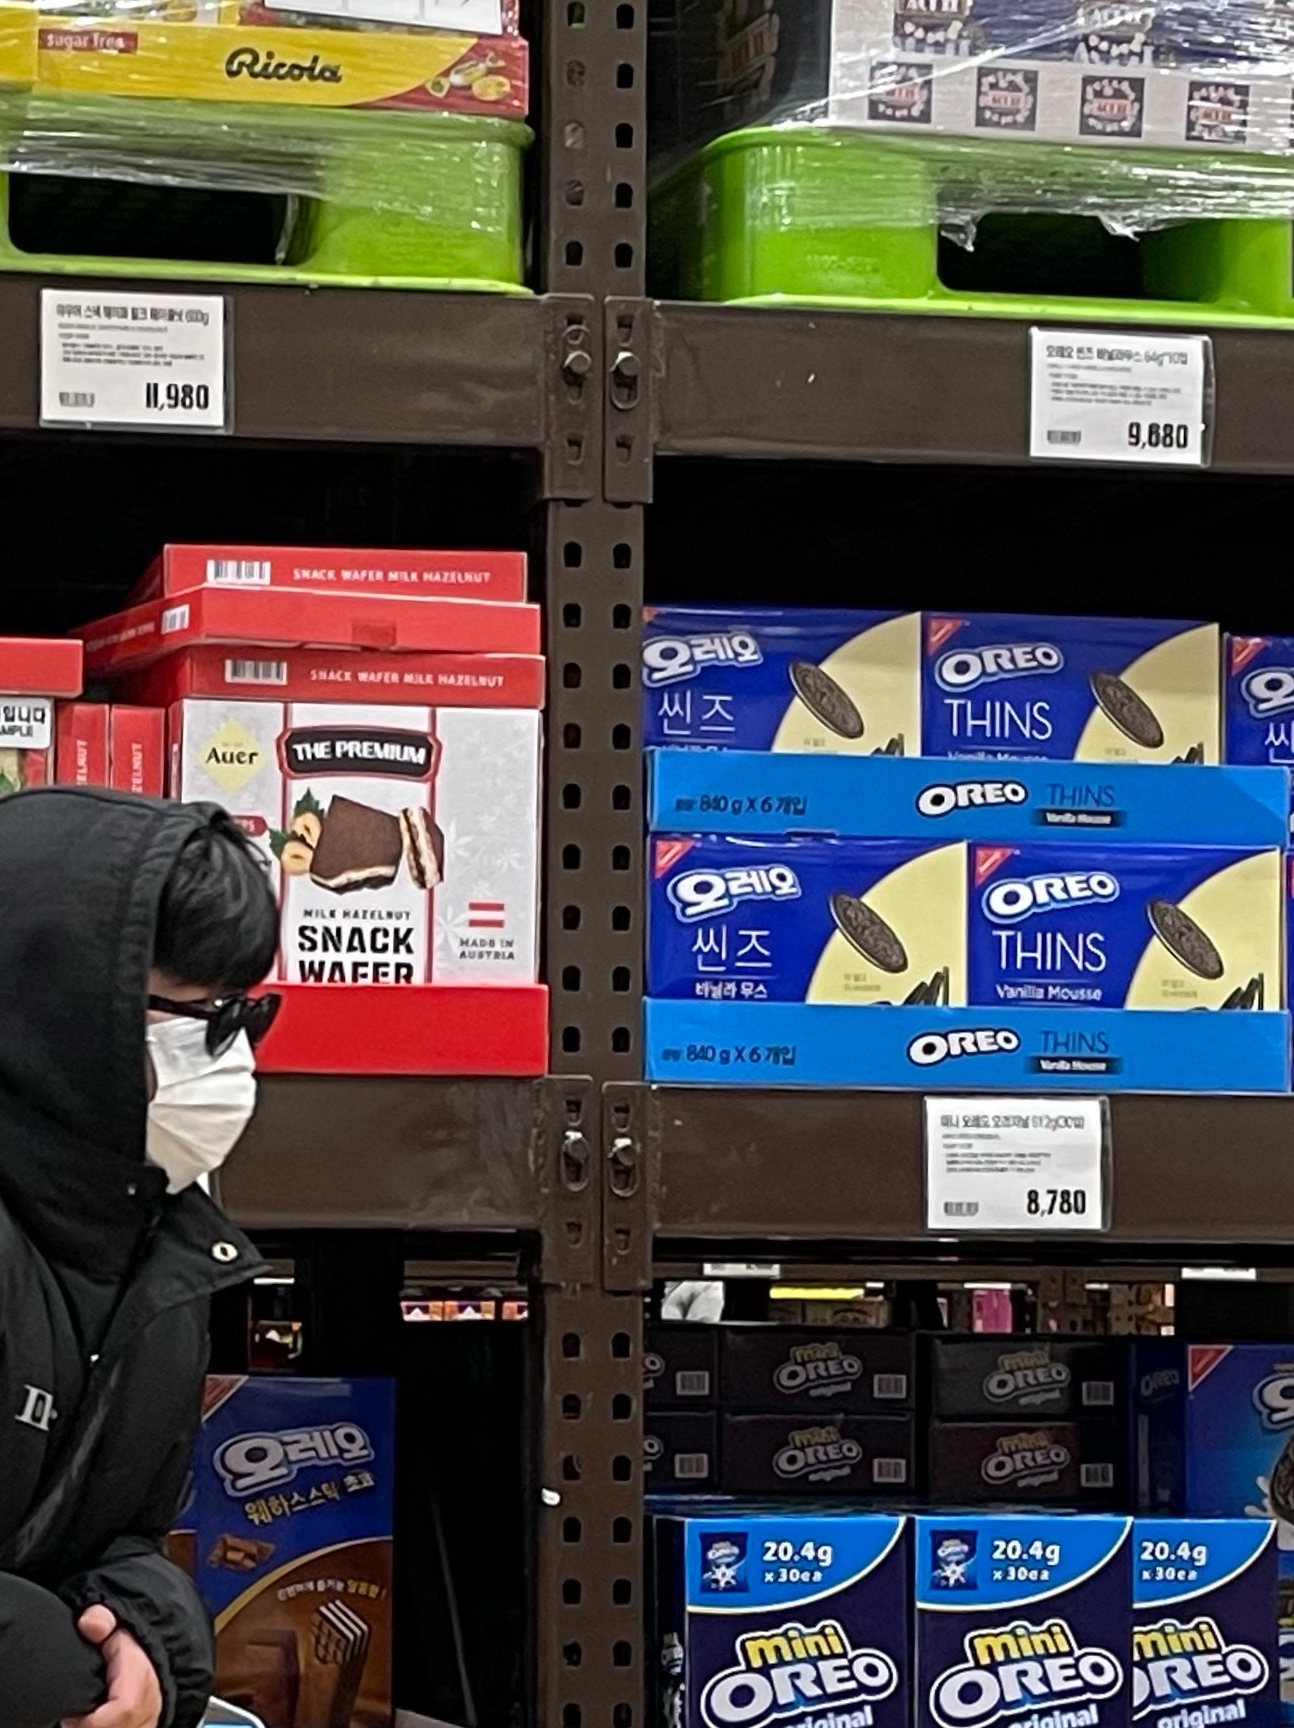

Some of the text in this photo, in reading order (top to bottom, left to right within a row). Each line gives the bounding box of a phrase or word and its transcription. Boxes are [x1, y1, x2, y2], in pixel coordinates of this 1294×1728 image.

[224, 46, 343, 84] Ricola
[145, 382, 210, 411] 11,980
[293, 567, 491, 584] SNACK WAFER MILK HAZELNUT
[643, 632, 762, 681] 오레오
[939, 646, 1060, 687] OREO
[310, 669, 505, 687] SNACK WAFER MILK HAZELNUT
[657, 689, 736, 736] 씬즈
[944, 698, 1053, 741] THINS
[206, 746, 259, 767] Auer
[293, 741, 426, 766] THE PREMIUM
[919, 783, 1027, 816] OREO
[1048, 783, 1117, 807] THINS
[675, 866, 799, 917] 오레오
[989, 874, 1117, 916] OREO
[303, 909, 412, 921] MILK HAZELNUT
[298, 925, 415, 955] SNACK
[459, 949, 515, 960] AUSTRIA
[691, 923, 773, 972] 씬즈
[992, 930, 1107, 972] THINS
[298, 960, 415, 985] WAFER
[996, 983, 1103, 1001] Vanilla Mousse
[686, 1044, 715, 1061] 840
[909, 1030, 1020, 1064] OREO
[1042, 1029, 1109, 1054] THINS
[1026, 1188, 1087, 1217] 8,780
[789, 1342, 842, 1363] mini
[776, 1358, 861, 1393] OREO
[985, 1363, 1071, 1400] OREO
[222, 1426, 372, 1490] 오레오
[776, 1441, 861, 1479] OREO
[983, 1447, 1070, 1484] OREO
[762, 1541, 834, 1567] 20.4g
[992, 1539, 1061, 1566] 20.4g
[1140, 1541, 1207, 1566] 20.4g
[743, 1625, 846, 1668] mini
[973, 1625, 1071, 1666] mini
[1133, 1623, 1218, 1661] mini
[708, 1654, 891, 1723] OREO
[938, 1651, 1116, 1719] OREO
